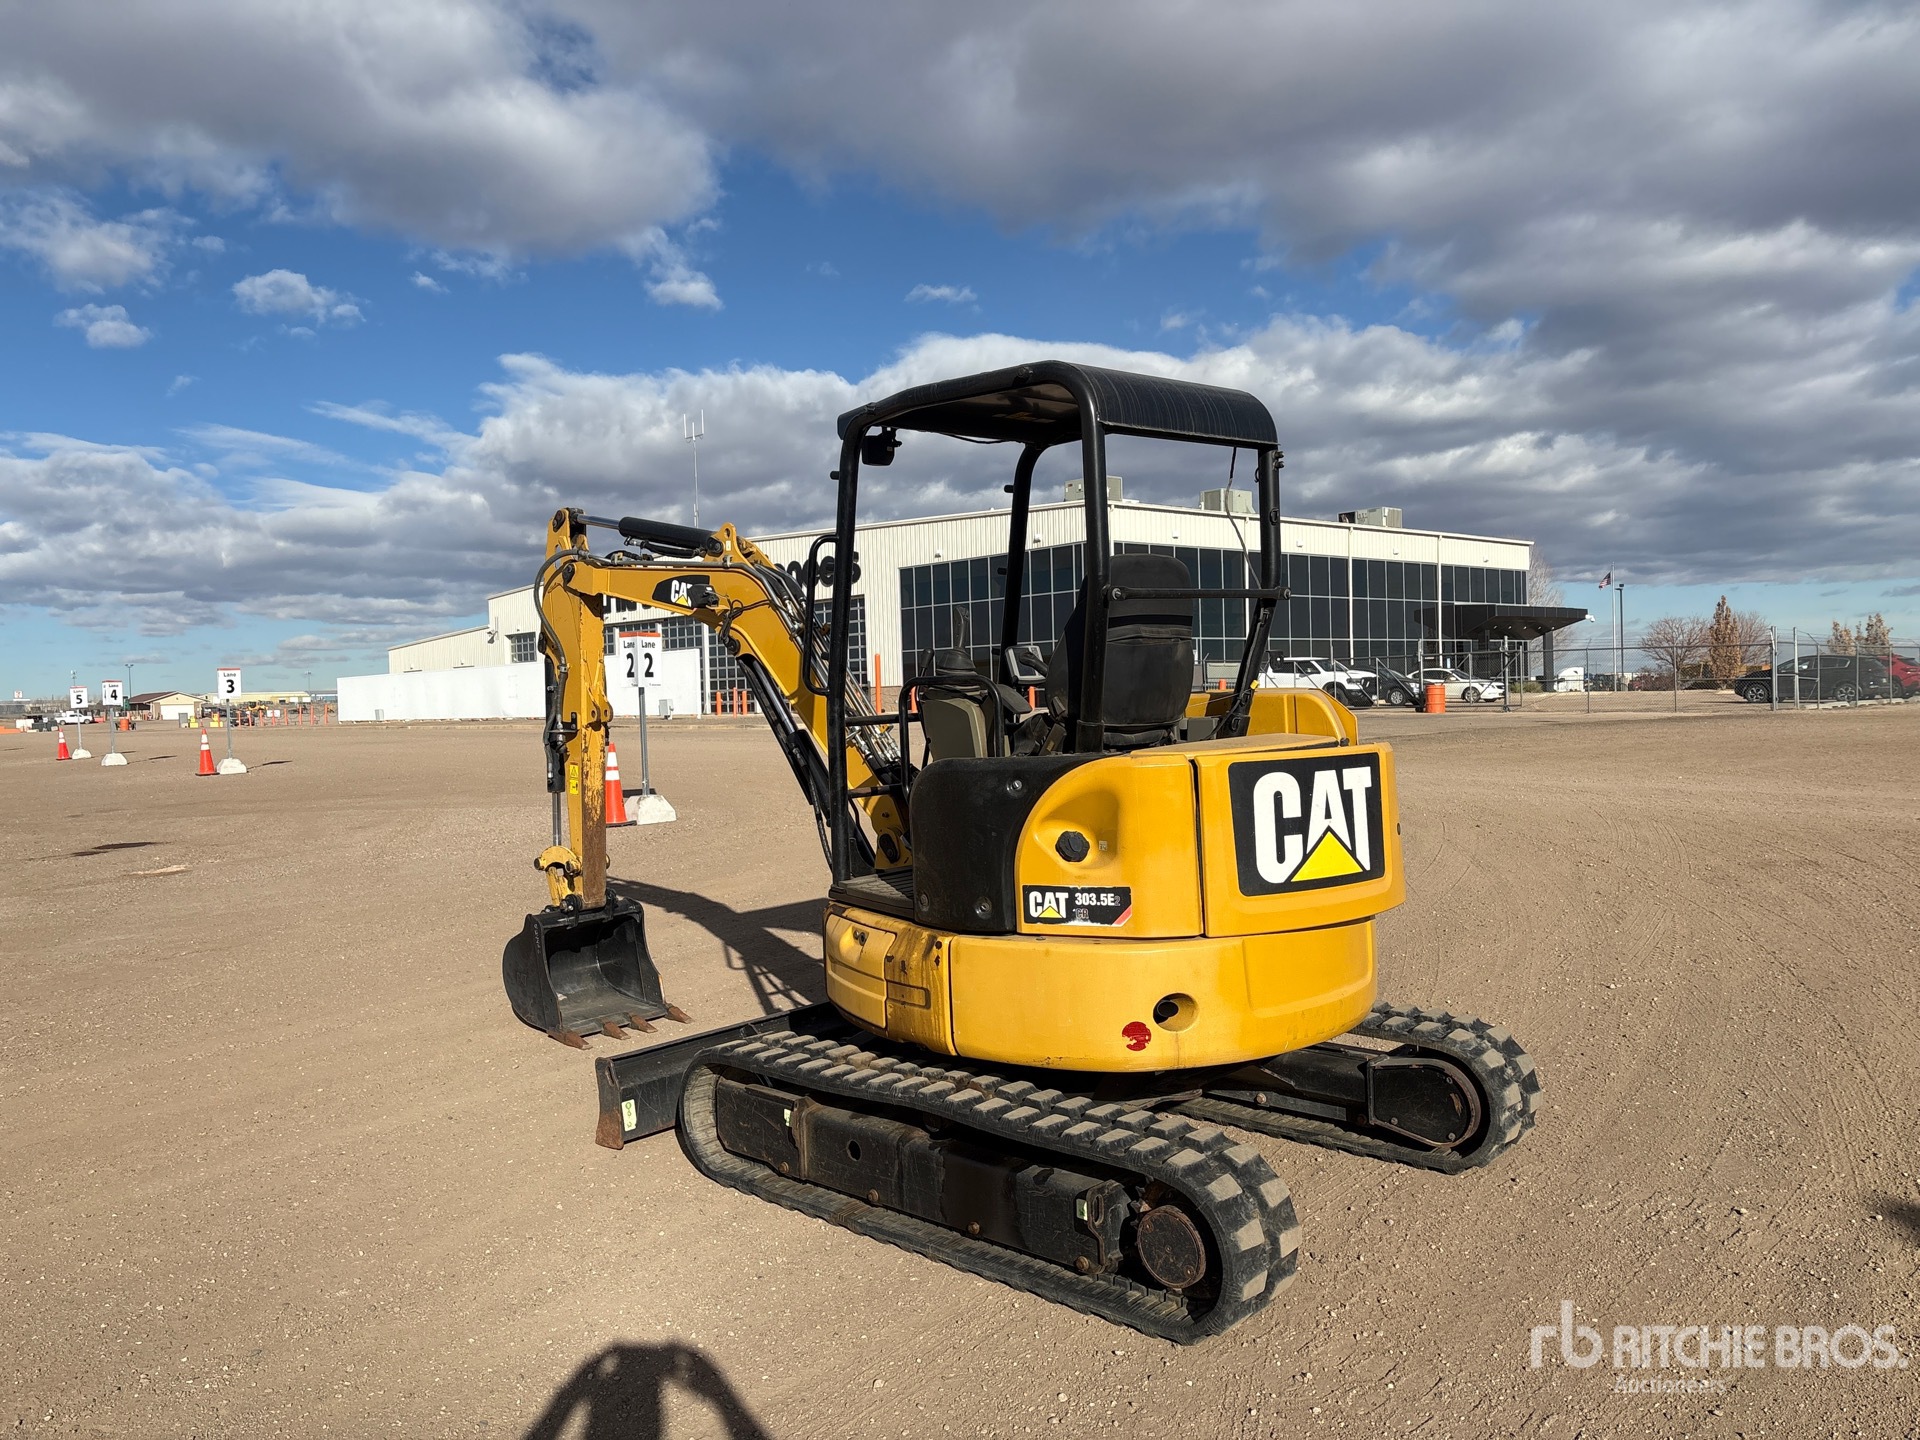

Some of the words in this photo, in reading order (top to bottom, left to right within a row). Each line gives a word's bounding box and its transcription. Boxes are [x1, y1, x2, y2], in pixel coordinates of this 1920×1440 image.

[623, 640, 636, 649] Lane
[641, 640, 656, 649] Lane
[626, 652, 635, 678] 2
[643, 652, 654, 678] 2
[226, 679, 235, 693] 3
[76, 694, 83, 705] 5
[110, 689, 118, 701] 4
[1253, 766, 1372, 884] CAT
[1029, 891, 1069, 919] CAT
